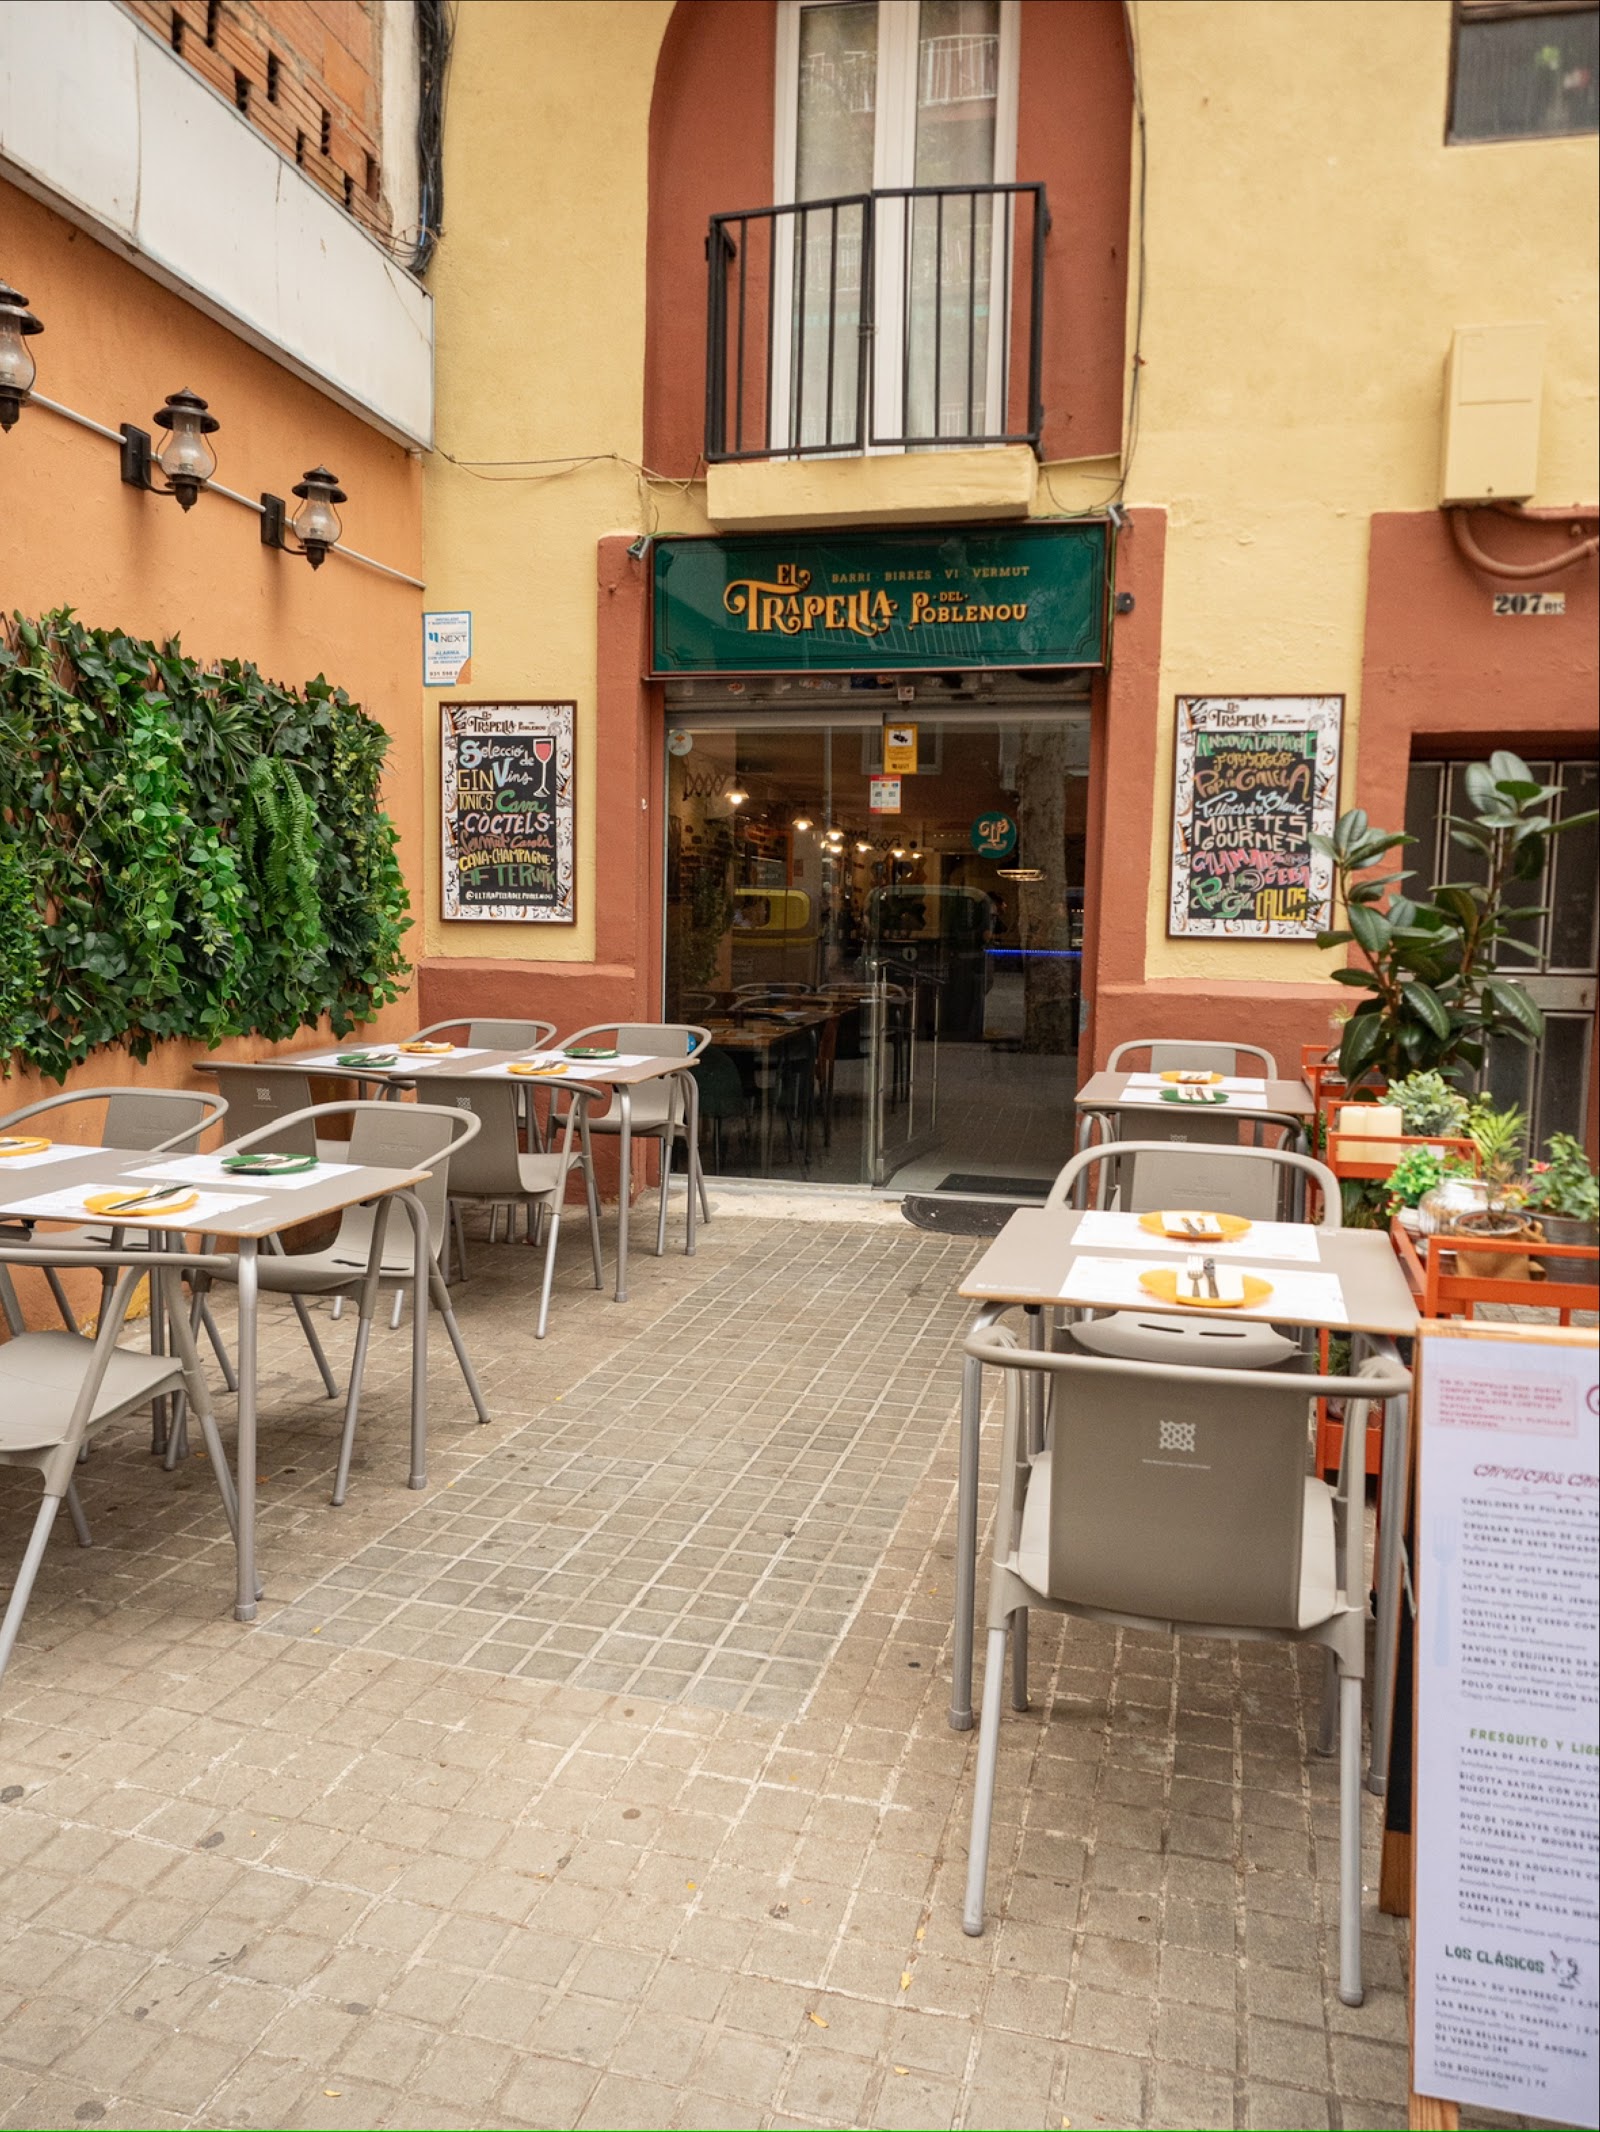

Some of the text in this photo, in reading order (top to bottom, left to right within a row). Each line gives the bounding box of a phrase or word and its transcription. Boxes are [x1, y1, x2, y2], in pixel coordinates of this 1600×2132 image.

[831, 565, 1030, 584] BARRI BIRRES VI VERMUT
[723, 564, 898, 637] EL TRAPELLA
[1495, 595, 1542, 614] 207
[909, 592, 1027, 631] POBLENOU
[441, 635, 467, 643] NEXT
[460, 739, 524, 768] Selecció
[458, 769, 493, 790] GIN
[492, 758, 533, 788] Vins
[496, 790, 547, 813] Cava
[1194, 815, 1307, 846] MOLLETES
[1202, 830, 1303, 852] GOURMET
[1516, 1589, 1548, 1600] POLLO
[1536, 1616, 1570, 1627] CERDO
[1462, 1643, 1508, 1656] RAVIOLIS
[1512, 1650, 1572, 1664] CRUJIENTES
[1511, 1662, 1555, 1672] CEBOLLA
[1462, 1680, 1493, 1689] POLLO
[1498, 1684, 1550, 1697] CRUJIENTE
[1470, 1728, 1548, 1749] FRESQUITO
[1556, 1740, 1563, 1751] Y
[1461, 1746, 1497, 1758] TARTAR
[1459, 1771, 1502, 1785] RICOTTA
[1459, 1783, 1498, 1796] NUECES
[1460, 1823, 1526, 1841] ALCAPARRAS
[1502, 1817, 1549, 1831] TOMATES
[1460, 1852, 1504, 1865] HUMMUS
[1526, 1863, 1580, 1878] AGUACATE
[1460, 1864, 1511, 1878] AHUMADO
[1459, 1890, 1513, 1905] BERENJENA
[1445, 1945, 1544, 1974] LOS CLÁSICOS
